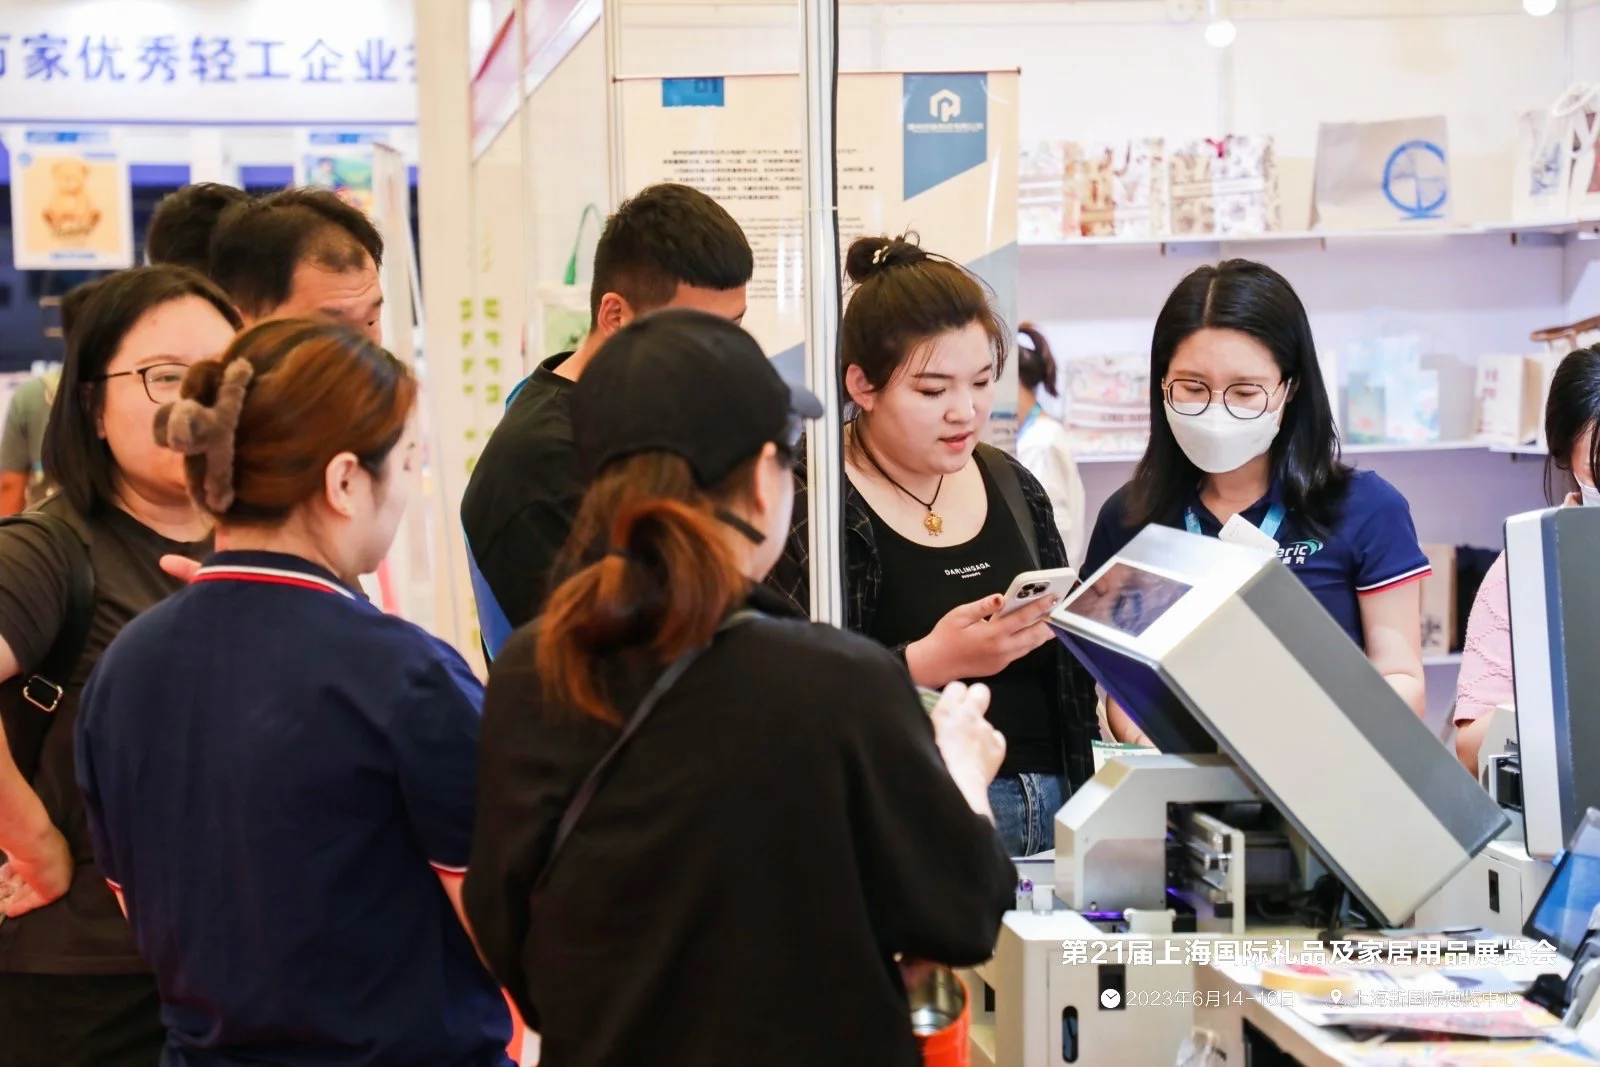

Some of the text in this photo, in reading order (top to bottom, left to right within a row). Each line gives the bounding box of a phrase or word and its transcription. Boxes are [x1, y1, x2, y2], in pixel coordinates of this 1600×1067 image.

[0, 33, 416, 83] 家优秀轻工企业
